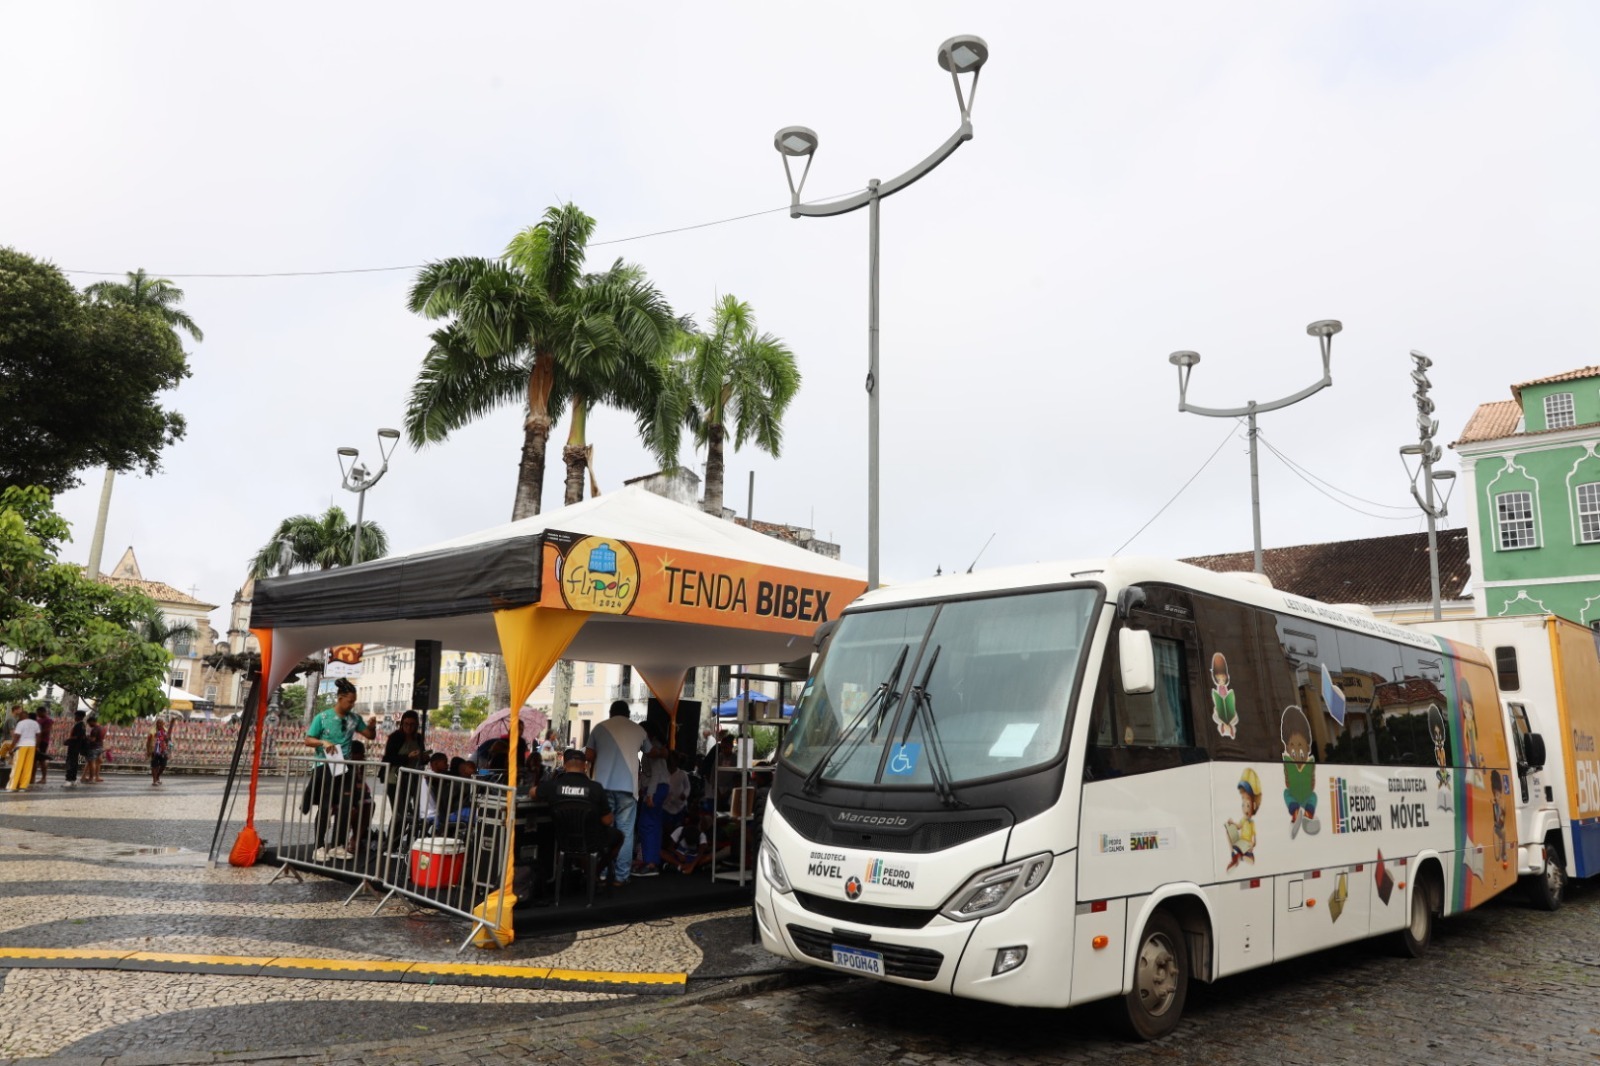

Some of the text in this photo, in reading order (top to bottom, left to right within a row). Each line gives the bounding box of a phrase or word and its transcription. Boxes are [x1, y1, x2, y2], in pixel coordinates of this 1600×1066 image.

[664, 566, 832, 622] TENDA BIBEX
[599, 599, 622, 608] 2024
[1388, 778, 1427, 792] BIBLIOTECA
[1349, 795, 1376, 812] PEDRO
[838, 812, 907, 826] Marcopolo
[1390, 796, 1430, 830] MÓVEL
[1351, 815, 1382, 832] CALMON
[1130, 836, 1159, 851] BAHIA
[810, 851, 846, 861] BIBLIOTECA
[808, 861, 843, 879] MÓVEL
[883, 868, 910, 879] PEDRO
[882, 877, 914, 890] CALMON
